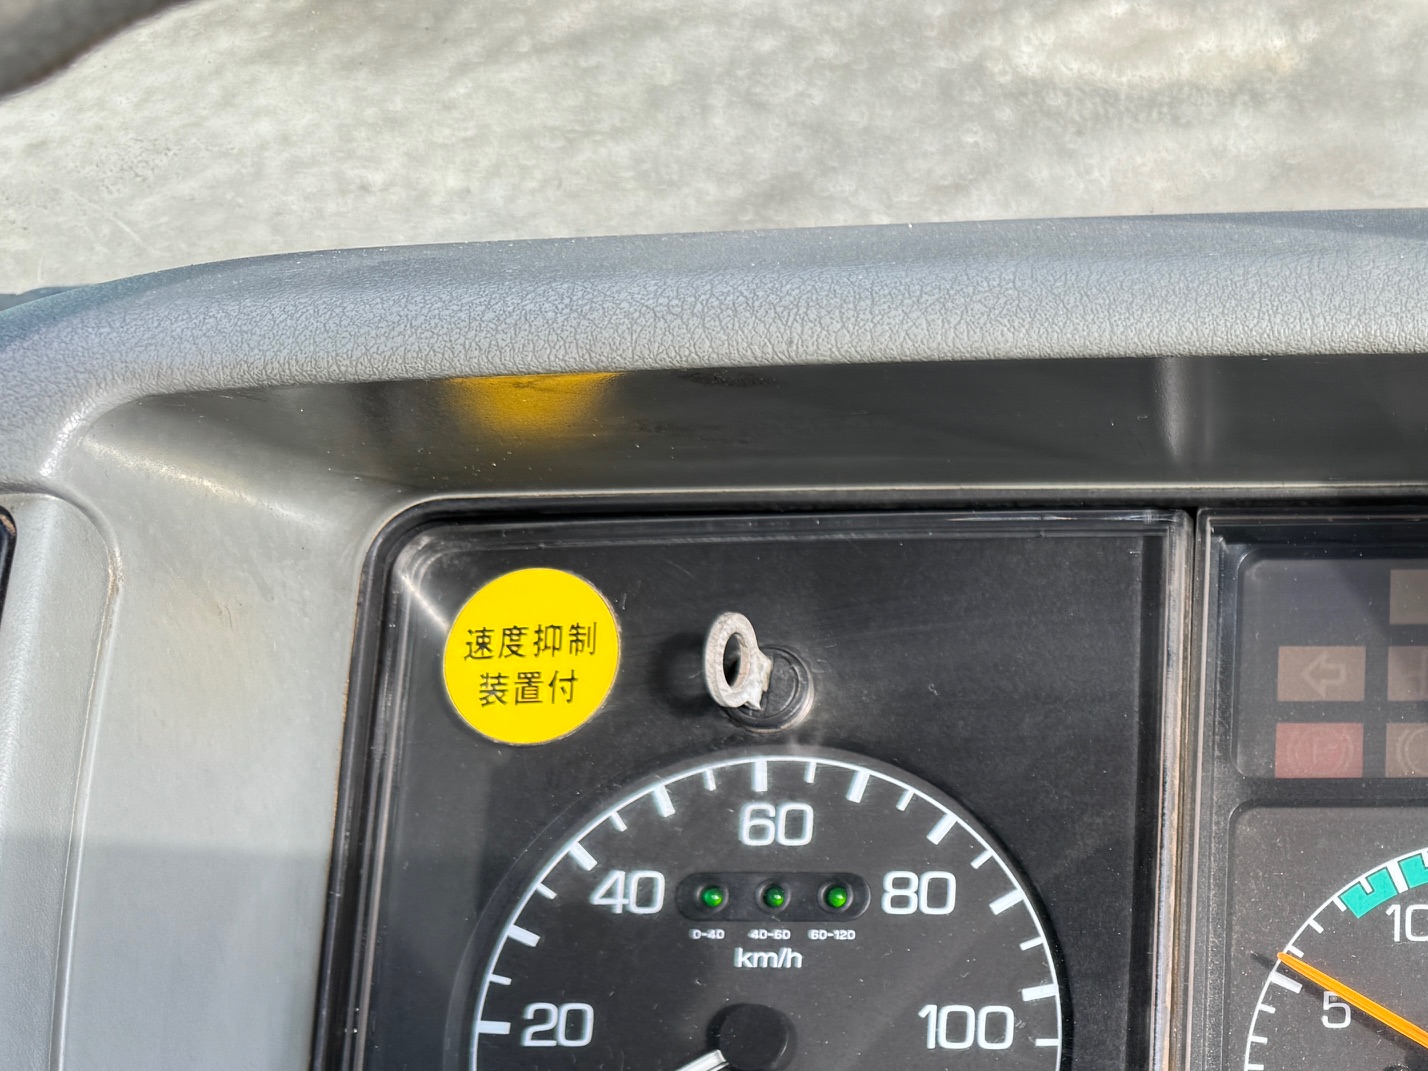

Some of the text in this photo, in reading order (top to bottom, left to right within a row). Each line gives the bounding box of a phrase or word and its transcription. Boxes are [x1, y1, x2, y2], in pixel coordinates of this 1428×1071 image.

[463, 621, 598, 662] 速度抑制
[478, 668, 580, 708] 装置付
[739, 803, 814, 847] 60
[590, 870, 666, 914] 40
[881, 871, 957, 916] 80
[689, 929, 725, 940] 0-40
[747, 929, 791, 940] 40-60
[807, 929, 856, 940] 60-120
[734, 947, 802, 968] km/h
[520, 1002, 594, 1048] 20
[918, 1004, 1015, 1051] 100
[1322, 990, 1351, 1029] 5
